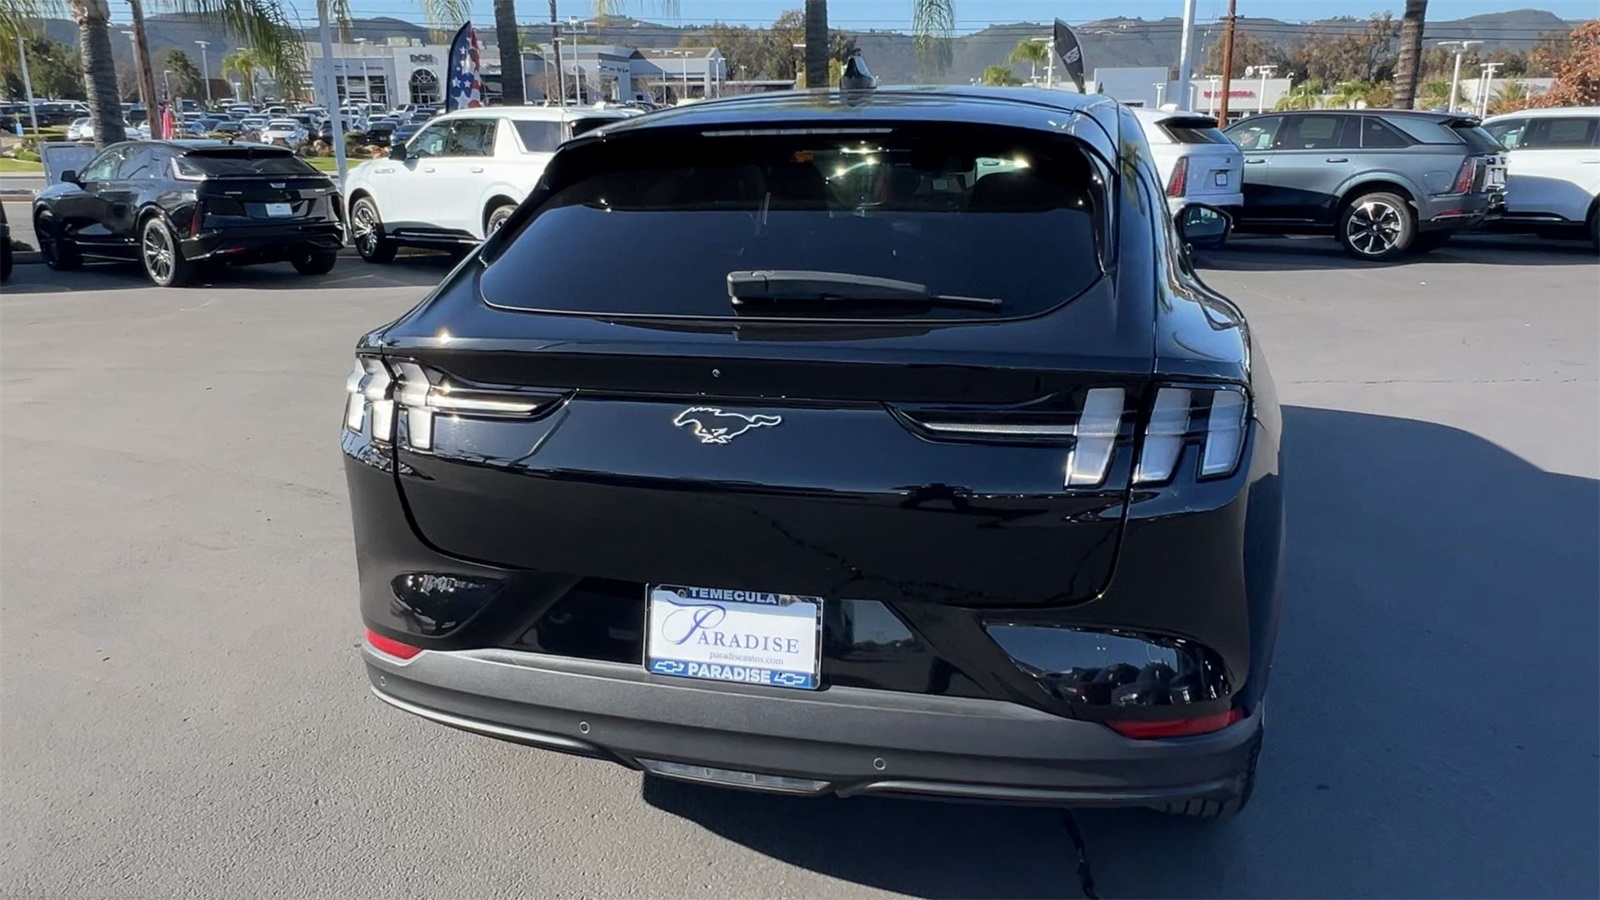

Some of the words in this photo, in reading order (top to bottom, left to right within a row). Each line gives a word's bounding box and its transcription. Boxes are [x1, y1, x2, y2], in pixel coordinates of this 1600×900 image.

[410, 54, 432, 62] DCH
[689, 587, 777, 604] TEMECULA
[662, 598, 799, 653] PARADISE
[709, 652, 784, 665] paradiseautos.com
[688, 663, 771, 683] PARADISE
